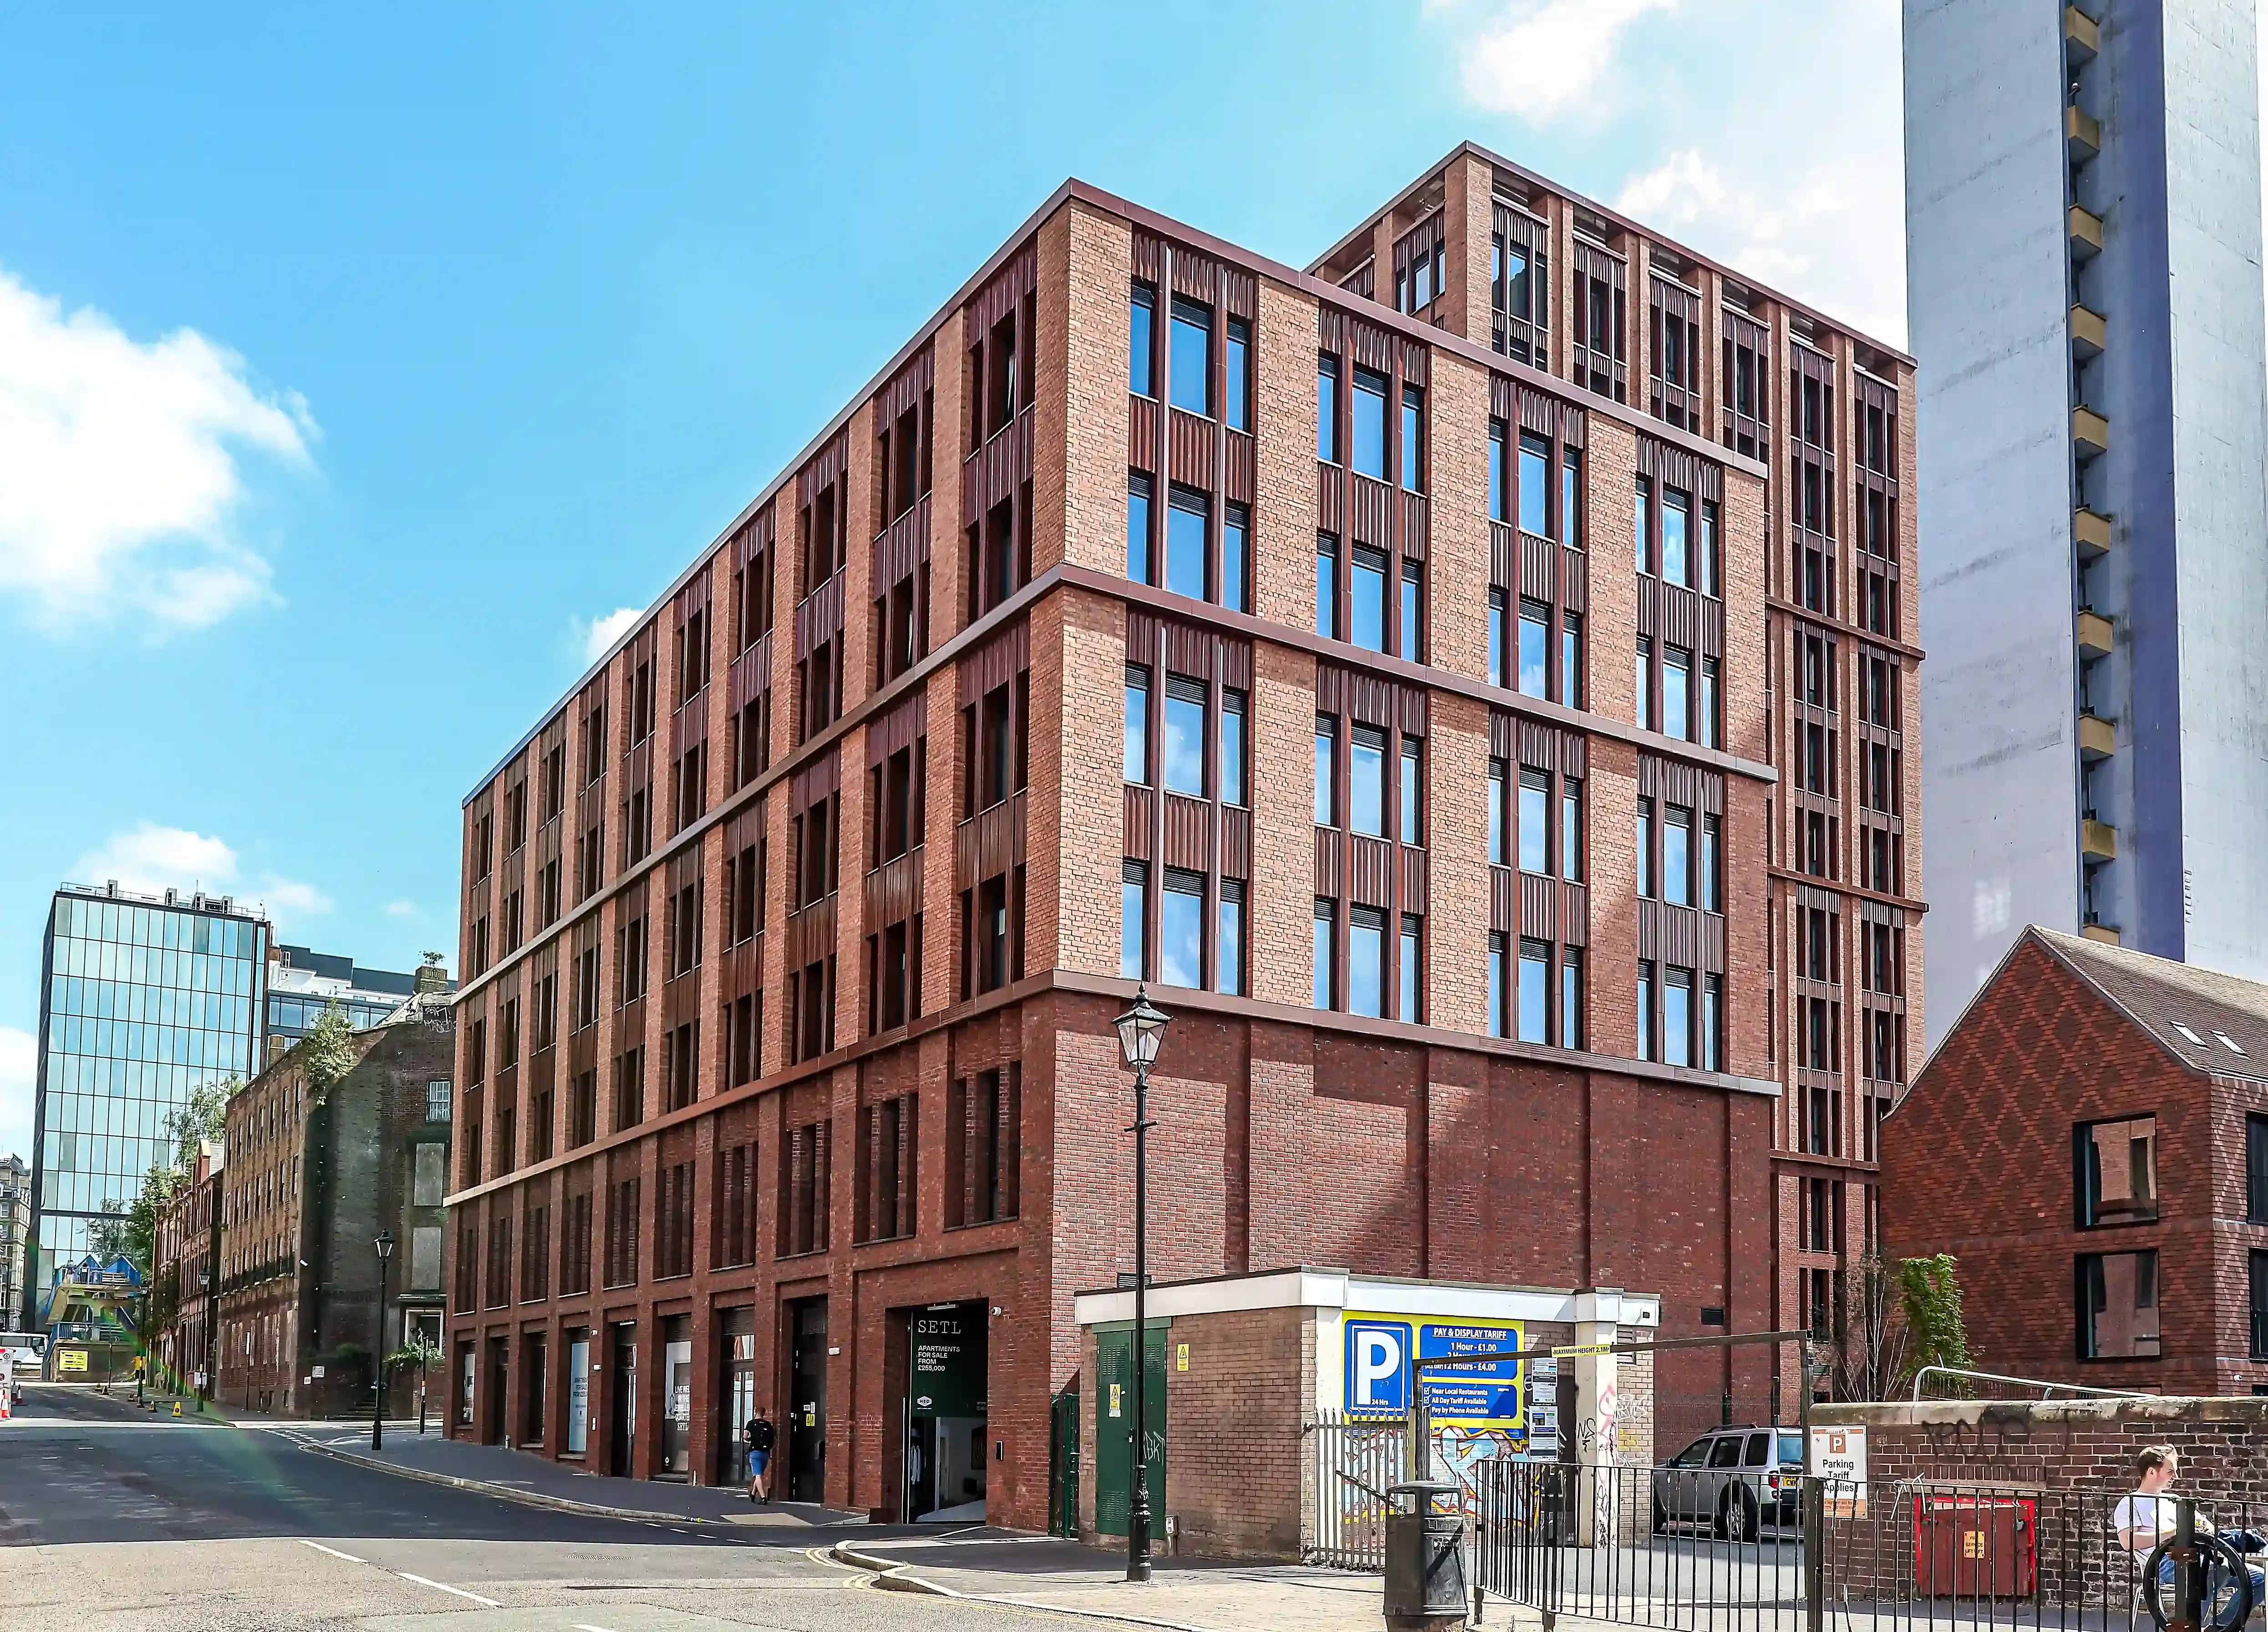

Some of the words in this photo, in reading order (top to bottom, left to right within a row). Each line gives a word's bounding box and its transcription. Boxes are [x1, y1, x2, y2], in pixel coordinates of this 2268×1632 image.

[918, 1320, 961, 1333] SETL
[1434, 1328, 1447, 1336] PAY
[1448, 1328, 1454, 1337] &
[1455, 1329, 1484, 1338] DISPLAY
[1485, 1330, 1506, 1339] TARIFF
[1451, 1342, 1454, 1350] 1
[1457, 1342, 1473, 1351] Hour
[1478, 1343, 1497, 1352] £1.00
[1357, 1331, 1400, 1405] P
[1477, 1363, 1497, 1371] £4.00
[1823, 1459, 1854, 1470] Parking
[1827, 1471, 1850, 1480] Tariff
